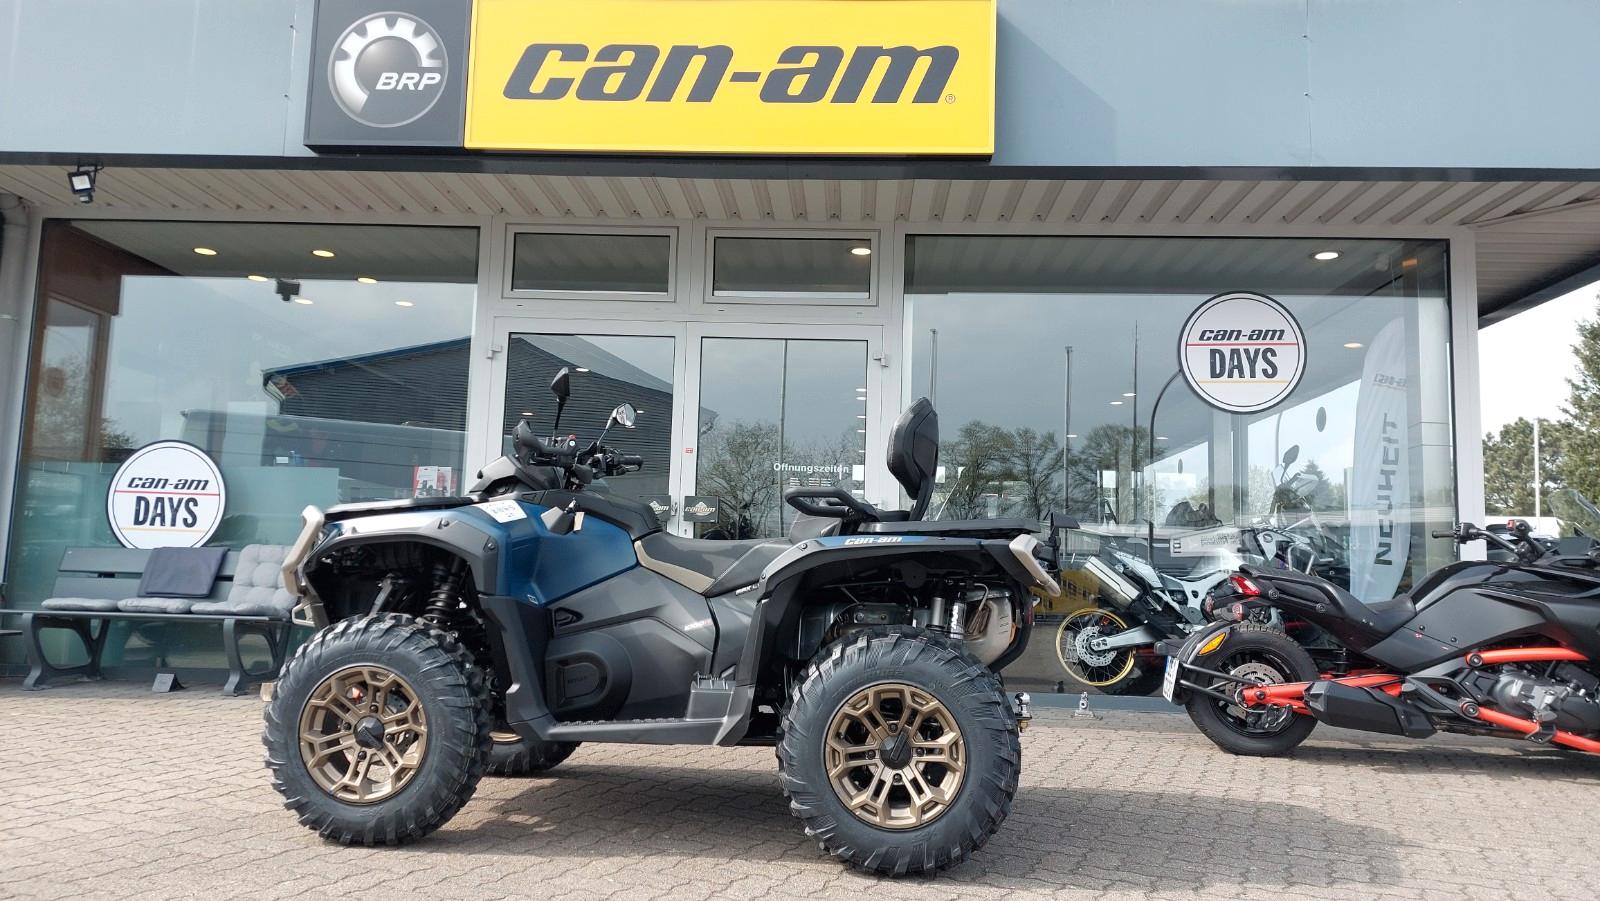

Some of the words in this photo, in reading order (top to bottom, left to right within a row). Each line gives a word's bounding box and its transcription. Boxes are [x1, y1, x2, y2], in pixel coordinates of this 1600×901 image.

[375, 72, 441, 91] BRP
[502, 43, 960, 104] can-am
[1198, 329, 1285, 342] can-am
[1209, 347, 1279, 379] DAYS
[127, 477, 209, 491] can-am
[1374, 412, 1400, 566] NEUHEIT
[133, 495, 199, 528] DAYS
[844, 536, 903, 546] can-am
